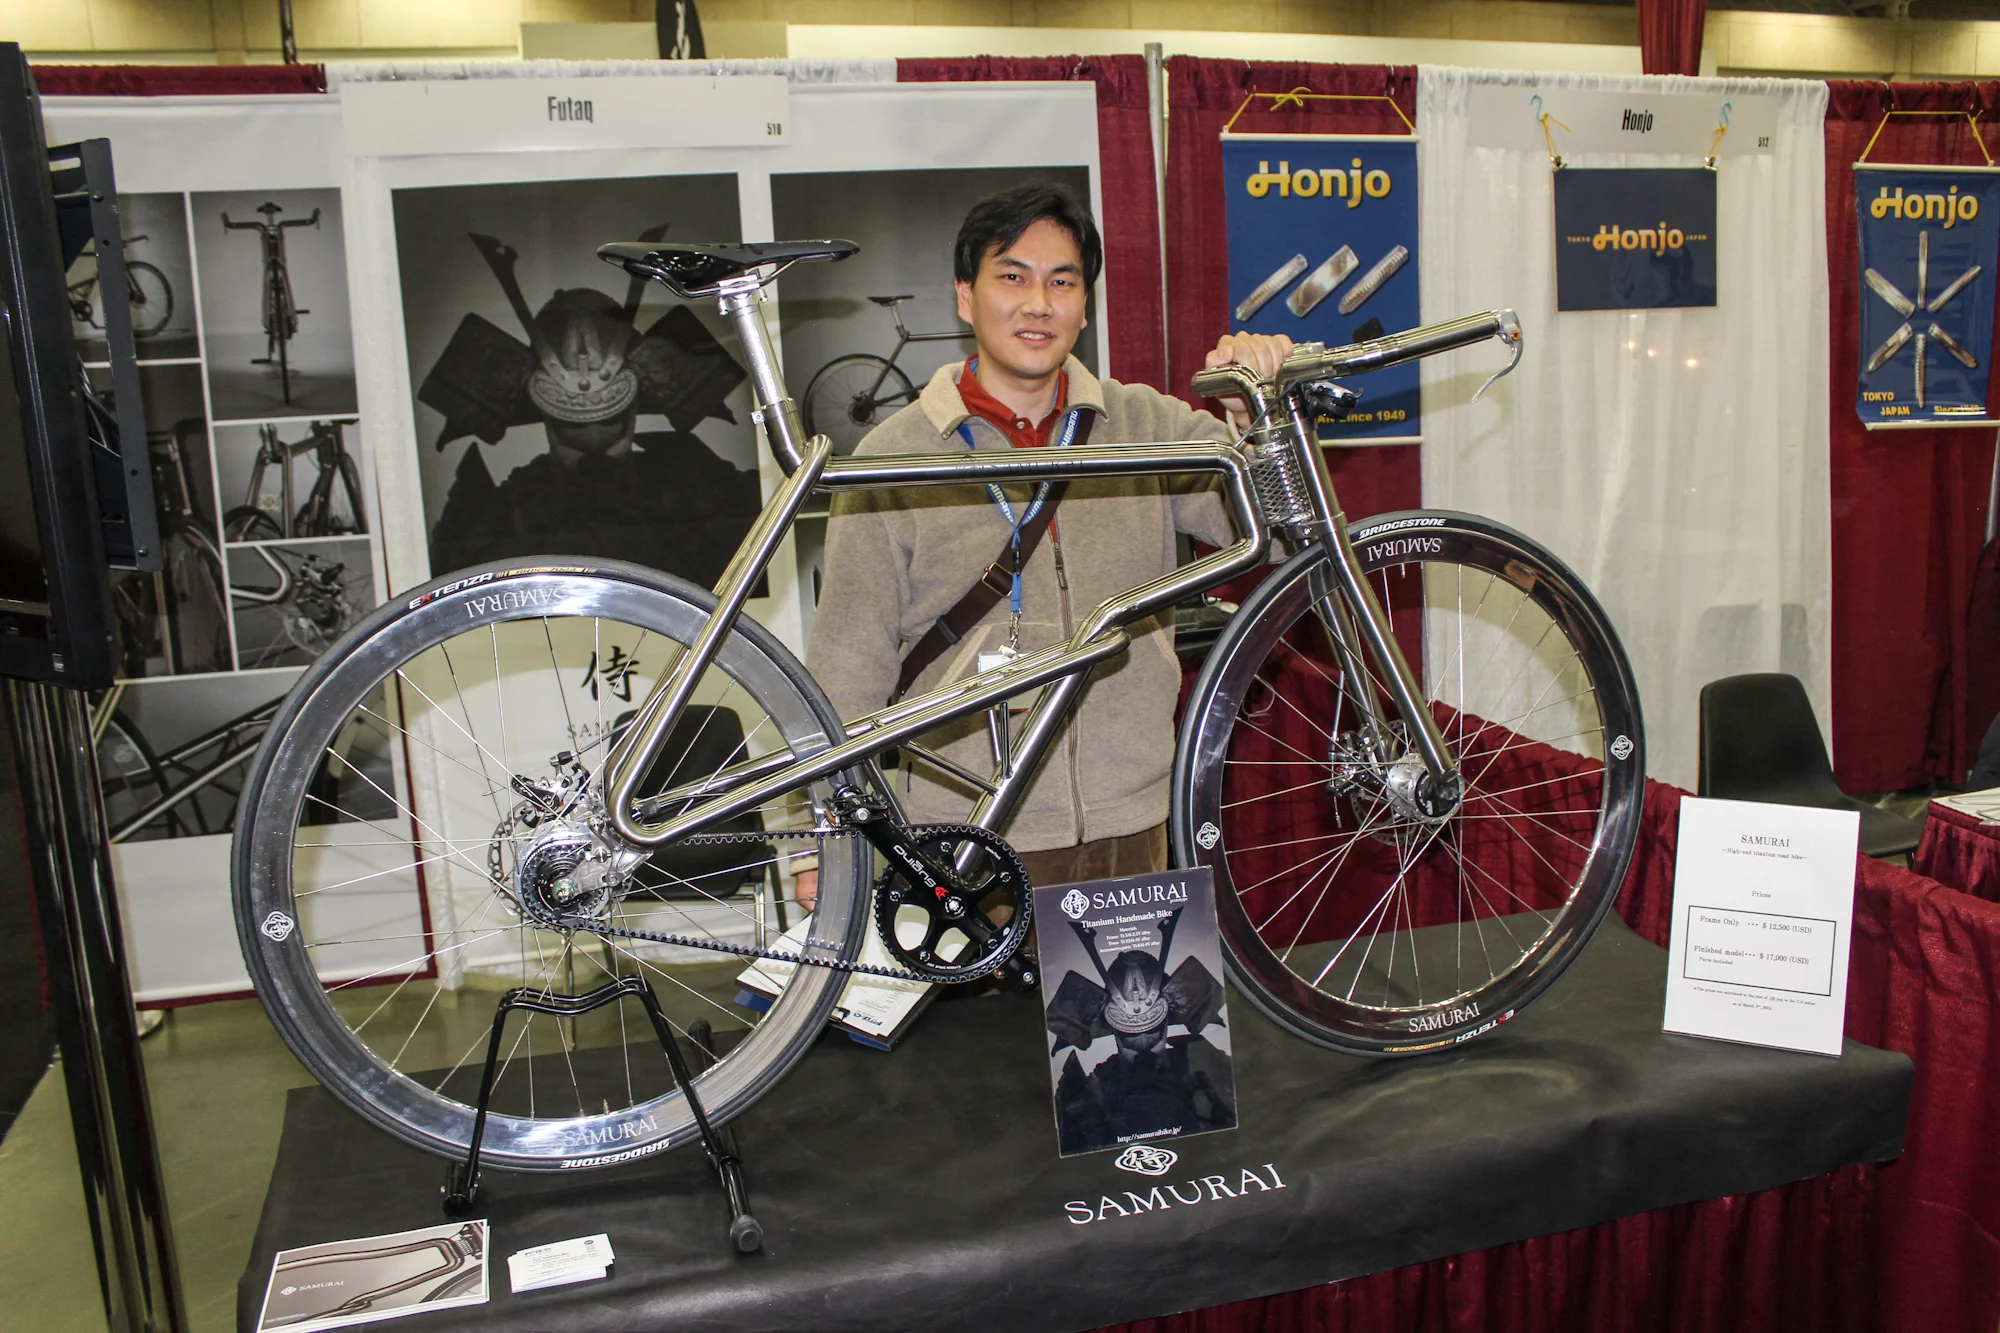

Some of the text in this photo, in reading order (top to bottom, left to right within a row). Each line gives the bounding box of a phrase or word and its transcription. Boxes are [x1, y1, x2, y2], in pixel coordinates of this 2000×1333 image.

[548, 96, 593, 123] Futaq
[1621, 109, 1653, 133] Honjo
[767, 122, 782, 135] 510
[1758, 137, 1769, 148] 512
[1246, 157, 1392, 209] Honjo
[1870, 184, 1979, 230] Honjo
[1592, 221, 1685, 257] Honjo
[1862, 391, 1895, 402] TOKYO
[1340, 412, 1373, 423] ince
[1376, 410, 1406, 421] 1949
[1881, 405, 1911, 416] JAPAN
[988, 483, 1014, 523] HIMANO
[1359, 517, 1447, 540] BRIDGESTONE
[1366, 537, 1443, 562] SAMURAI
[409, 572, 494, 610] EXTENZA
[463, 586, 569, 619] SAMURAI
[580, 645, 641, 703] 侍
[1740, 834, 1791, 848] SAMURAI
[1093, 881, 1188, 910] SAMURAI
[1751, 890, 1771, 899] Prices
[1081, 909, 1173, 929] Titanium Handmade Bike
[1700, 915, 1721, 924] Frame
[1723, 917, 1740, 927] Only
[1769, 923, 1790, 932] 12,500
[1792, 924, 1812, 934] (USD)
[1694, 944, 1723, 954] Finished
[1766, 953, 1788, 962] 17,000
[1789, 955, 1809, 965] (USD)
[1408, 1001, 1481, 1033] SAMURAI
[1456, 1009, 1515, 1043] EXTENZA
[563, 1115, 659, 1148] SAMURAI
[1116, 1125, 1182, 1144] http://samuraibike.jp/
[560, 1138, 670, 1169] BRIDGESTONE
[1064, 1163, 1287, 1225] SAMURAI
[299, 1280, 345, 1291] SAMURAI
